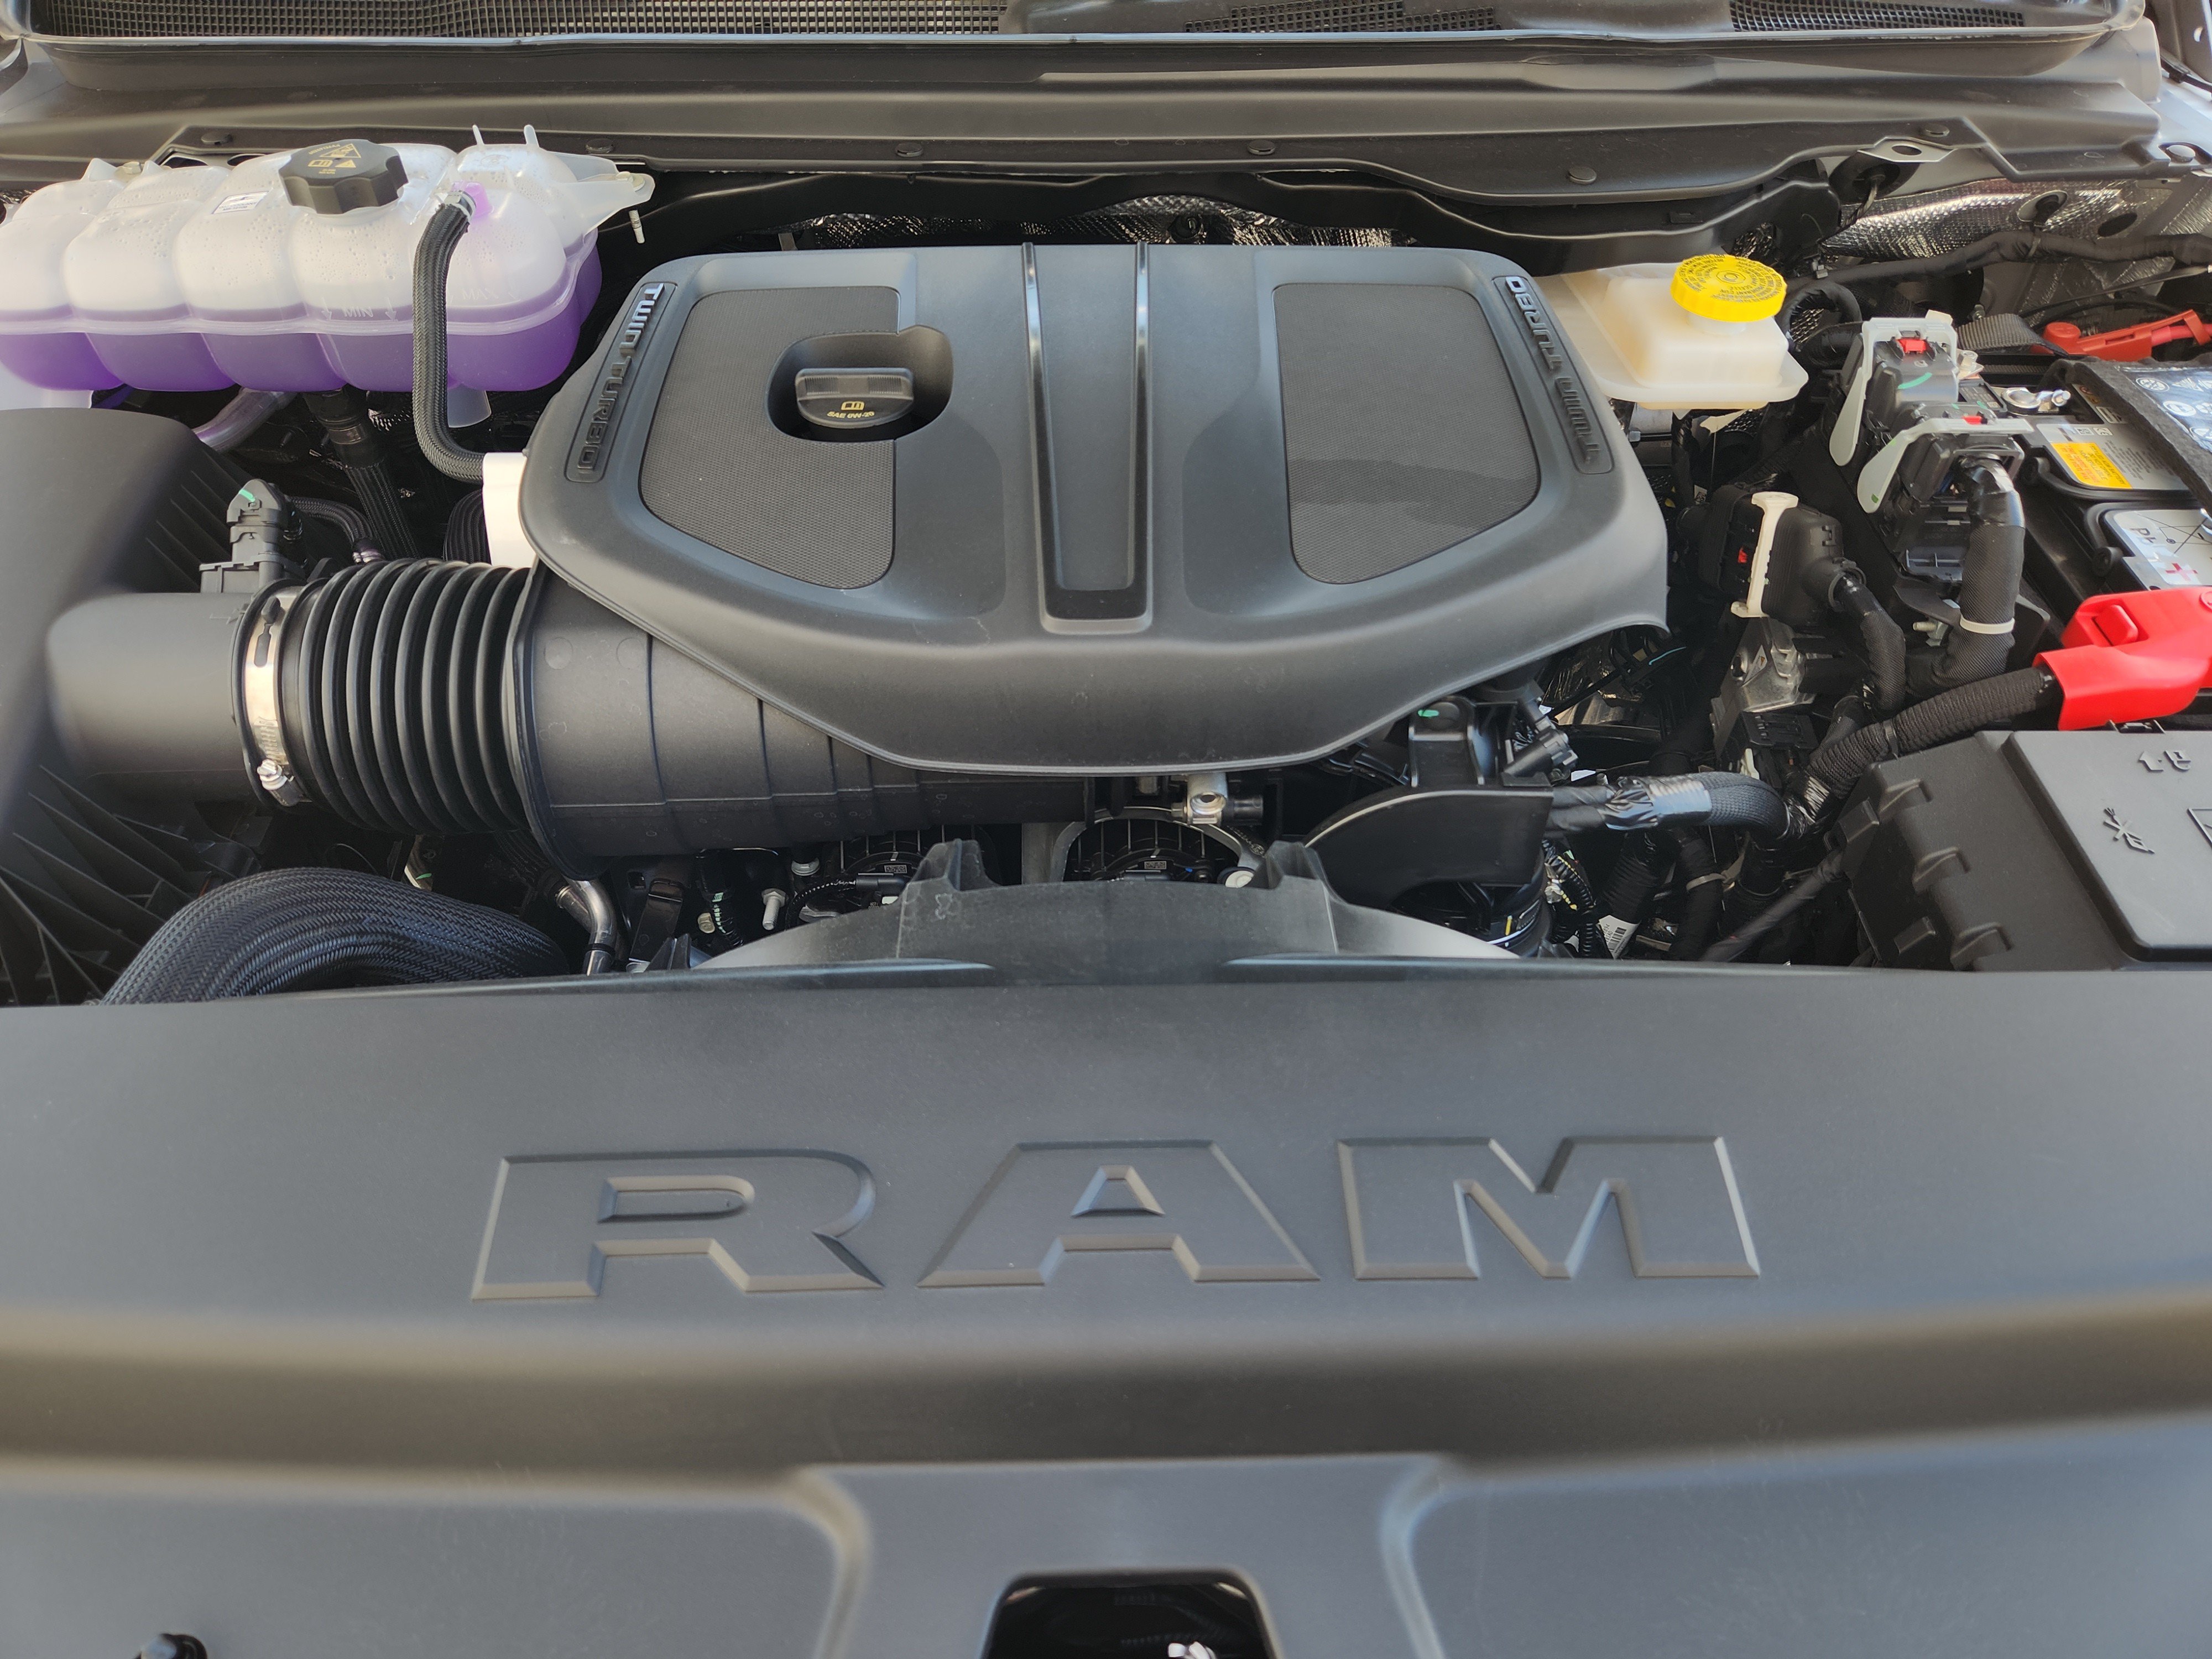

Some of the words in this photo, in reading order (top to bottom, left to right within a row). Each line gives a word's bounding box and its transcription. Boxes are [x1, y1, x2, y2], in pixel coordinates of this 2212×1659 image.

[342, 306, 374, 319] MIN
[619, 283, 664, 357] TWIN
[577, 356, 632, 470] TURBO
[1505, 276, 1562, 371] TURBO
[1554, 377, 1600, 463] TWIN
[2109, 468, 2126, 484] BATTERY
[471, 1135, 1761, 1301] RAM
